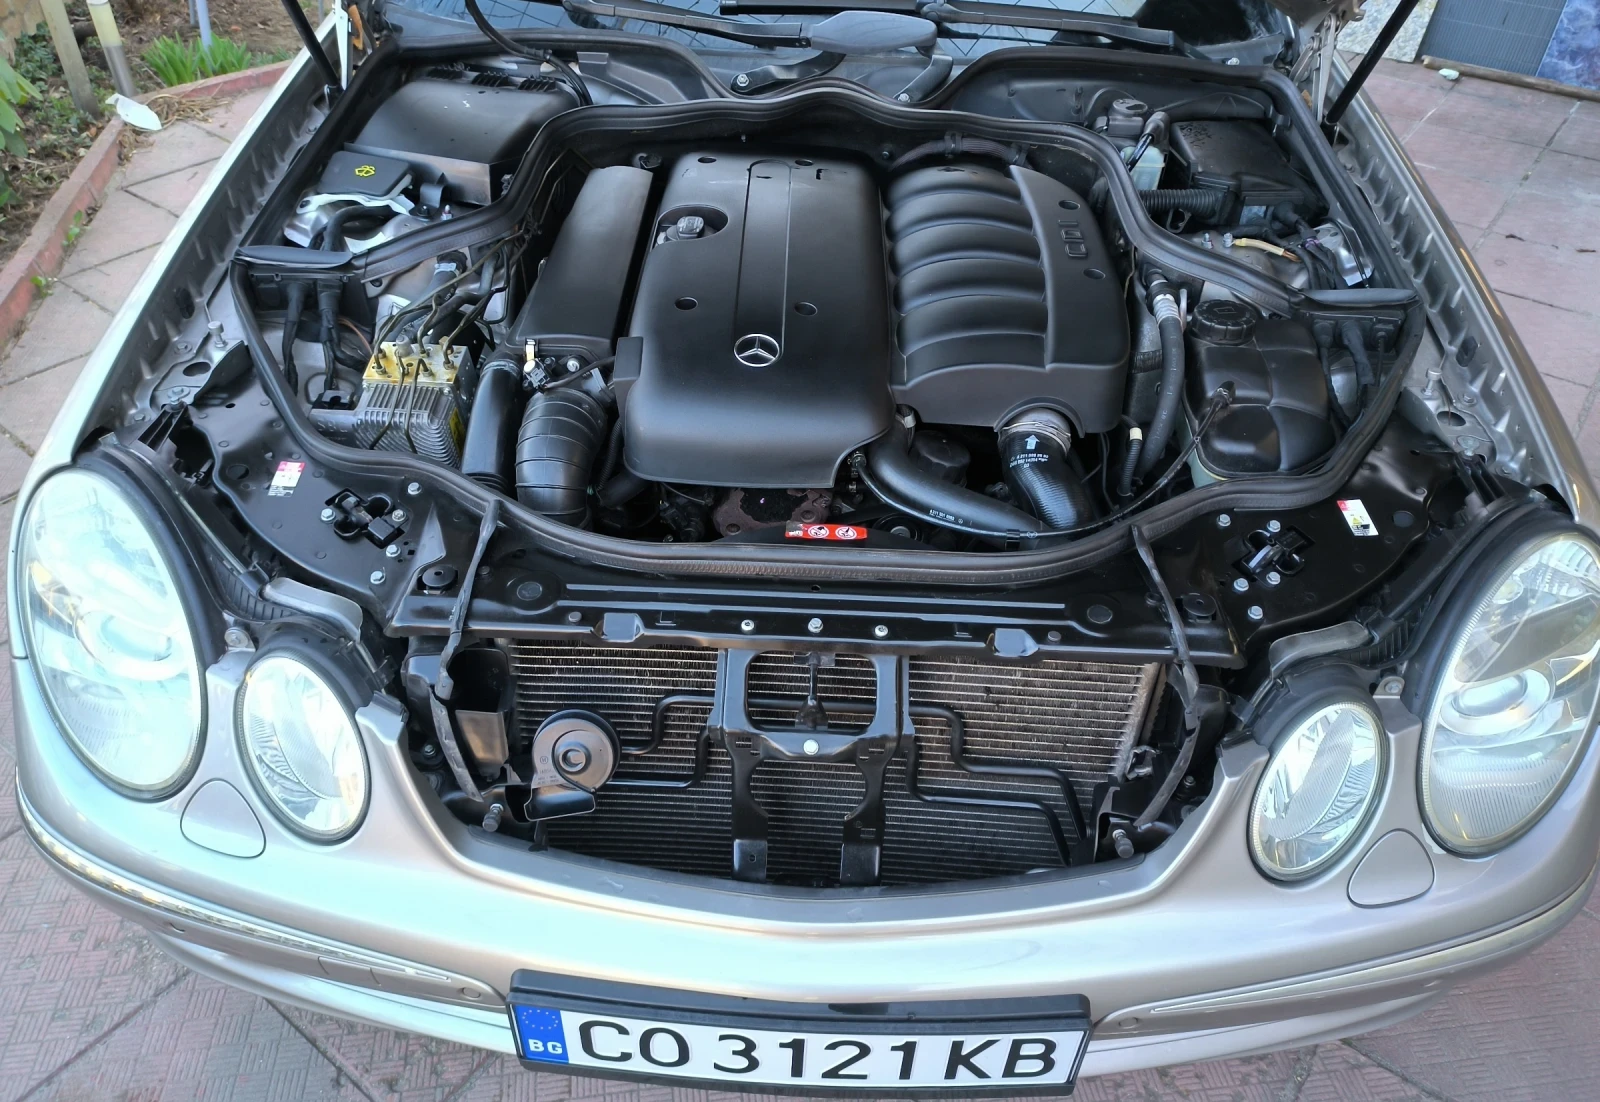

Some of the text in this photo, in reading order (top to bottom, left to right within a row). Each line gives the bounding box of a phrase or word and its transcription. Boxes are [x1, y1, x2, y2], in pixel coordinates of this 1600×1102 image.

[1058, 219, 1088, 257] CDI
[528, 1039, 563, 1055] BG
[578, 1020, 1057, 1080] CO 3121 KB
